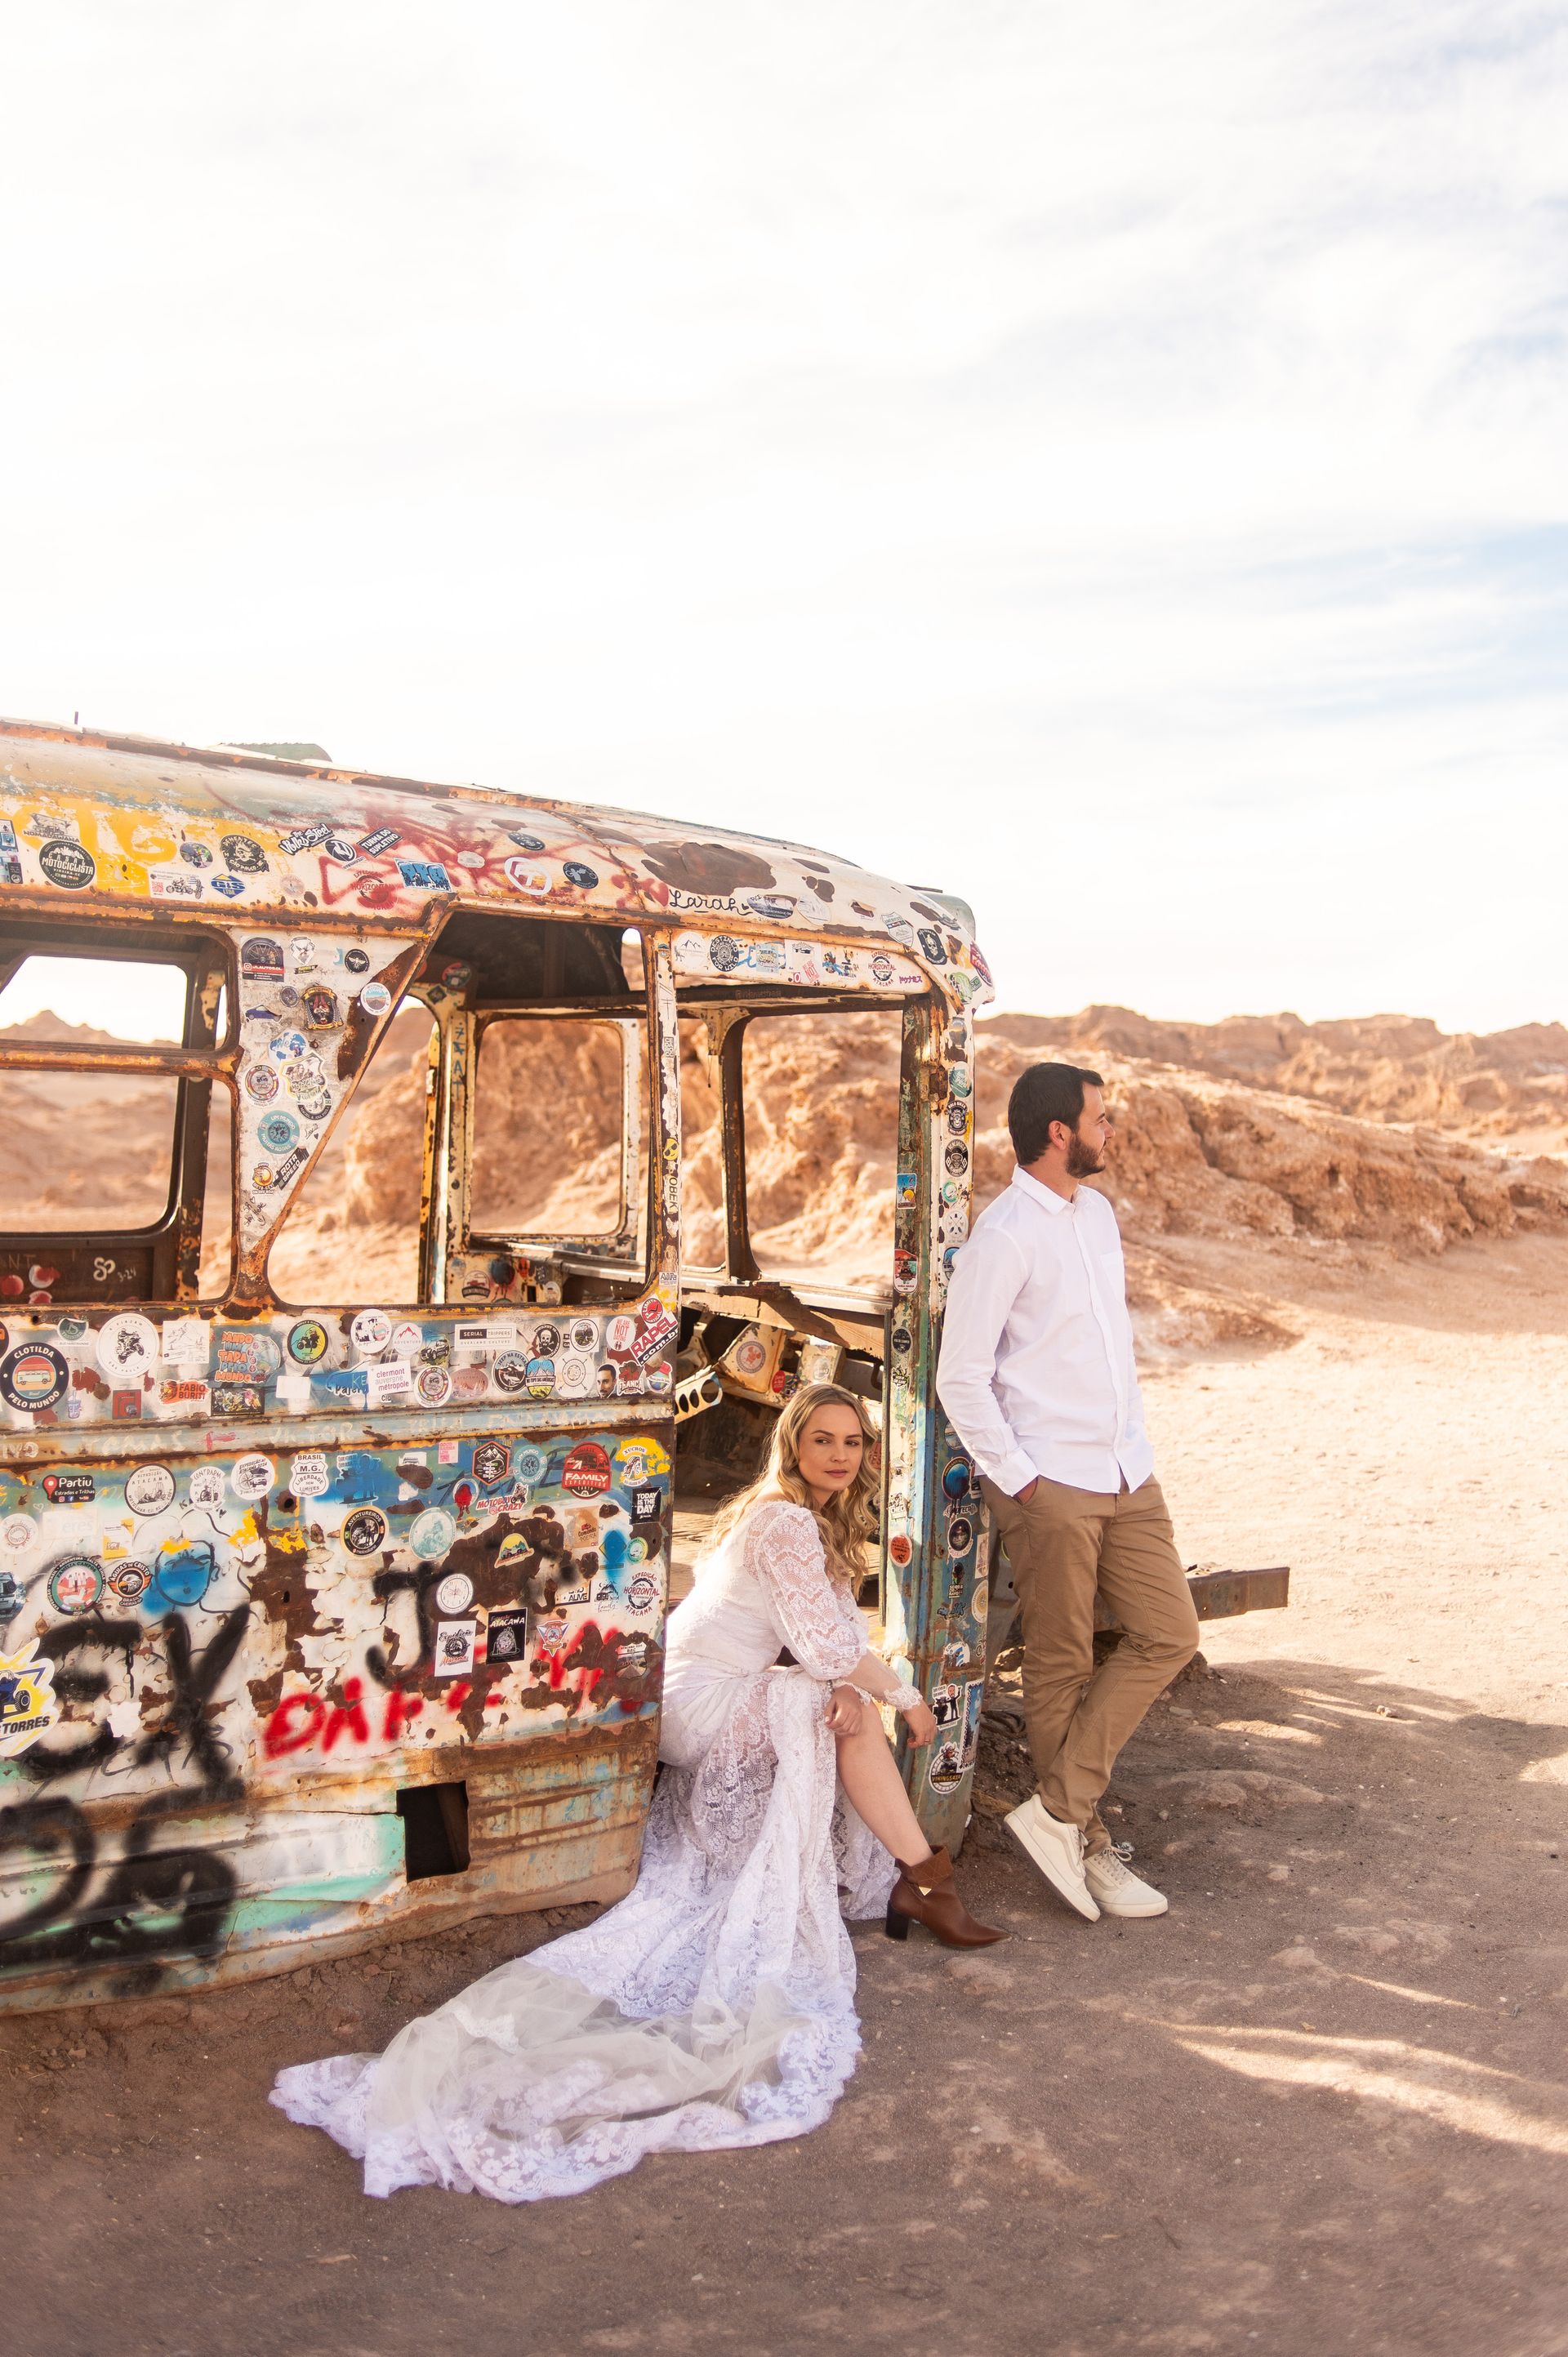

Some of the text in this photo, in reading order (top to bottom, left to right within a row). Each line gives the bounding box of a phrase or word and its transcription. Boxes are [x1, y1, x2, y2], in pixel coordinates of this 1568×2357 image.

[362, 828, 391, 849] TURMA DO
[368, 833, 399, 855] SUPLETIVO
[42, 857, 94, 876] MOTOCICLISTA
[669, 889, 748, 916] Larah
[868, 964, 897, 972] HORIZONTAL
[280, 1153, 298, 1176] ROTA
[283, 1159, 301, 1183] SPEED
[669, 1177, 678, 1209] OBEK
[614, 1325, 630, 1337] NOT
[630, 1317, 677, 1357] RAPEL
[13, 1345, 55, 1359] CLOTILDA
[376, 1367, 406, 1379] clermont
[375, 1375, 404, 1386] auvergne
[8, 1390, 60, 1410] PELO MUNDO
[58, 1477, 93, 1488] Partiu
[131, 1476, 169, 1486] ATACAMA
[295, 1474, 324, 1486] LIBERDADE
[565, 1473, 609, 1481] FAMILY
[564, 1479, 607, 1488] EXPEDITION
[497, 1503, 523, 1513] CRAZY
[636, 1504, 655, 1514] DAY
[347, 1510, 383, 1527] AVENTUREIROS
[133, 1562, 150, 1575] CRISTO
[631, 1571, 657, 1582] EXPEDIÇÃO
[568, 1593, 588, 1602] ALIVE
[623, 1587, 661, 1596] HORIZONTAL
[624, 1604, 654, 1617] ATACAMA
[3, 1715, 51, 1735] TORRES
